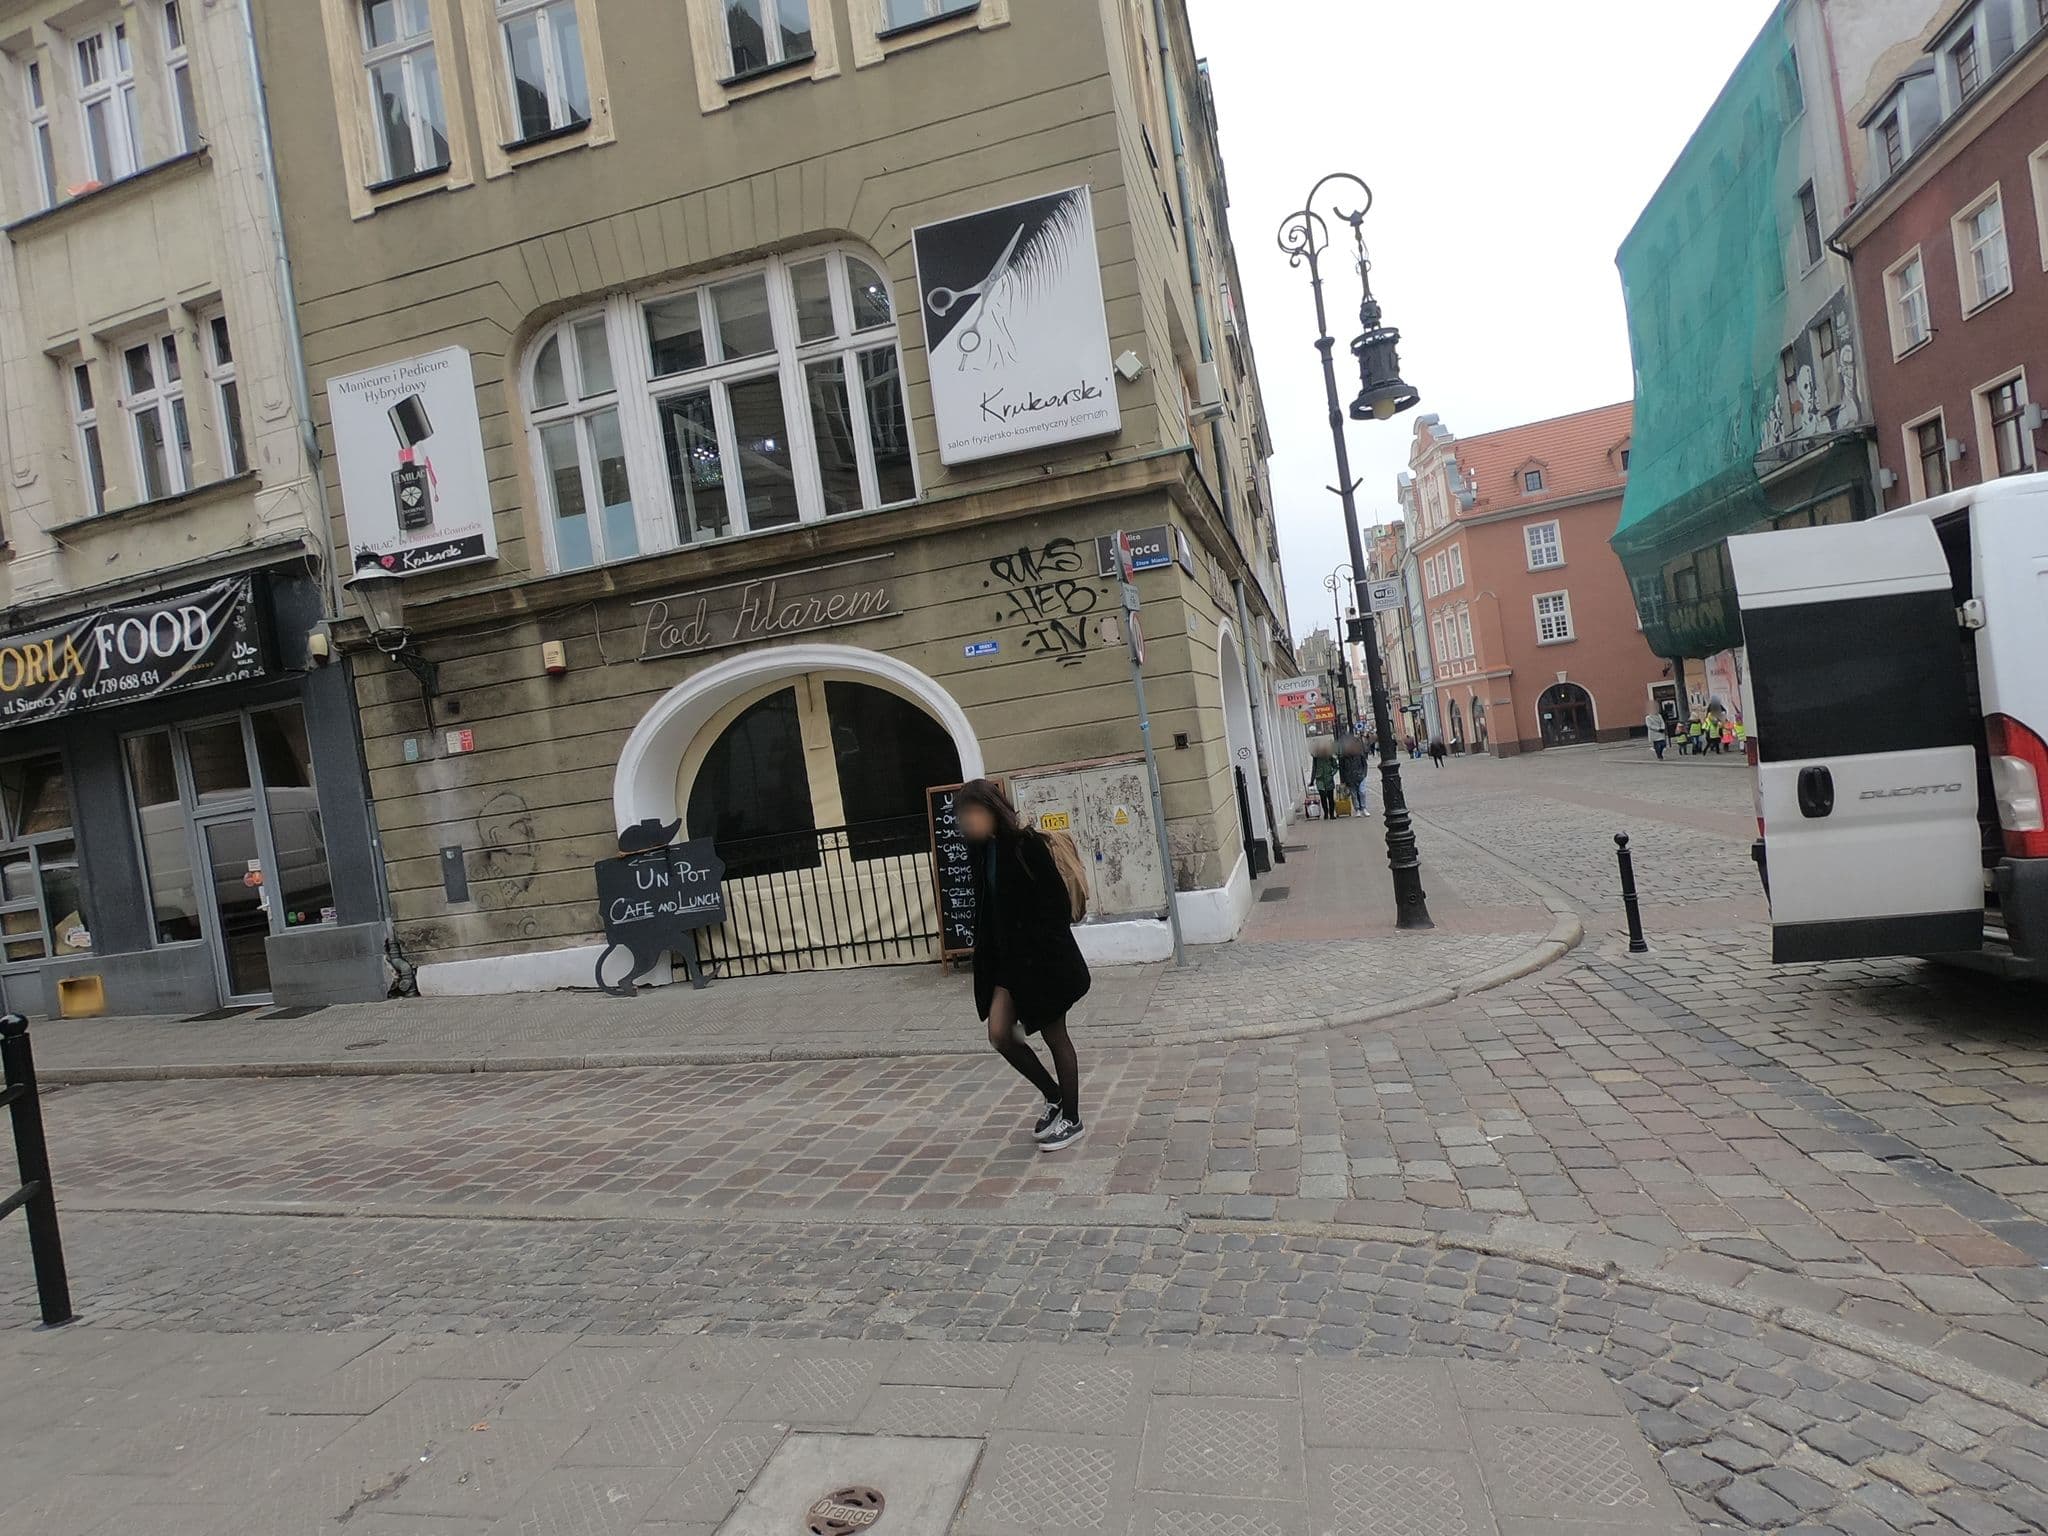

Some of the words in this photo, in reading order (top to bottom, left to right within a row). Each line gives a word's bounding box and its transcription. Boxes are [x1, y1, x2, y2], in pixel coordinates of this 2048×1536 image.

[338, 375, 391, 394] Manicure
[392, 369, 398, 380] i
[399, 360, 449, 379] Pedicure
[364, 380, 427, 404] Hybrydowy
[947, 439, 970, 450] salon
[972, 418, 1069, 446] fryzjersko-kosmetyczny
[95, 605, 212, 671] FOOD
[640, 597, 711, 656] Pod
[58, 686, 77, 706] 5/6
[100, 679, 118, 695] 739
[119, 674, 140, 690] 688
[140, 669, 160, 685] 434
[1859, 783, 1962, 800] DUCATO
[815, 1498, 876, 1526] Orange
